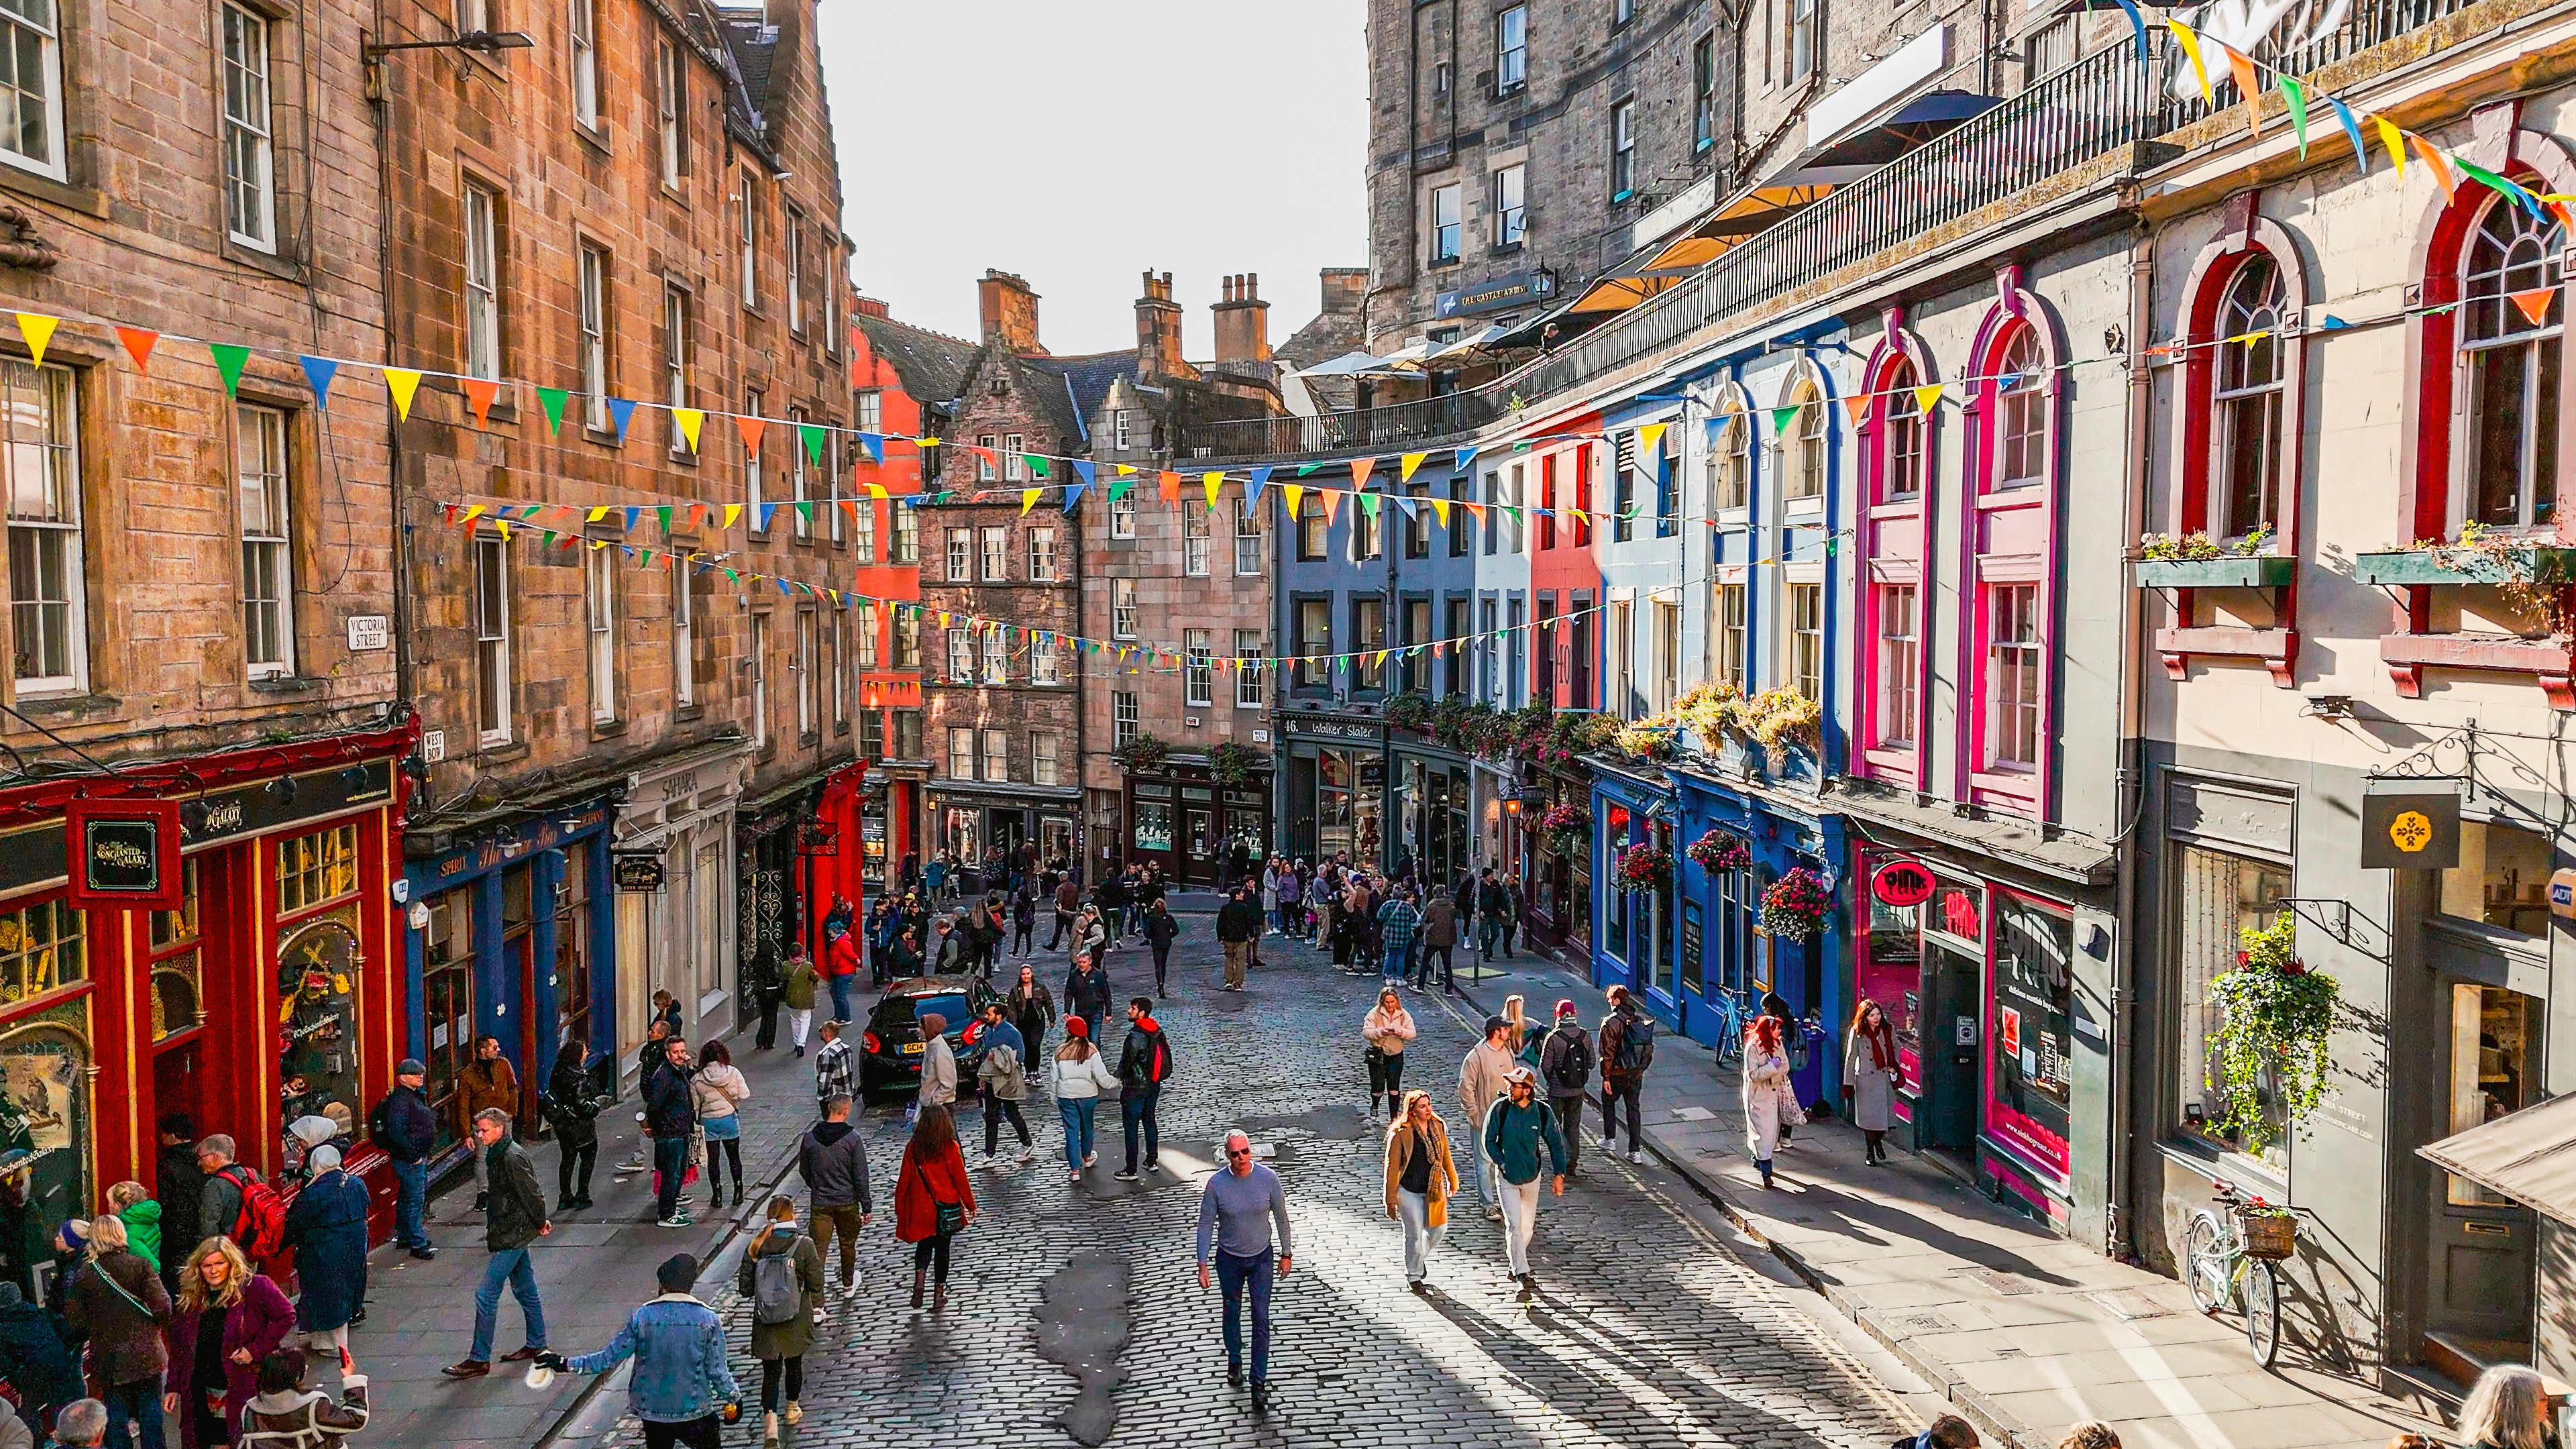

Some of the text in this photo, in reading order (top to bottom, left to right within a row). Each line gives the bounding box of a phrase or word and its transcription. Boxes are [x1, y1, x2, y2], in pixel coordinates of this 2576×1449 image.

[1462, 285, 1524, 306] THE CASTLE ARMS
[350, 619, 385, 632] VICTORIA
[356, 633, 382, 647] STREET
[1556, 644, 1570, 685] 40
[1312, 722, 1342, 735] Walker
[1347, 724, 1373, 738] Slater
[425, 733, 442, 745] WEST
[427, 746, 441, 760] BOW
[662, 771, 698, 802] SAHARA
[440, 857, 466, 877] SPIRIT
[2553, 888, 2572, 902] ADT
[906, 1043, 924, 1052] GC14
[2339, 1106, 2367, 1122] STREET
